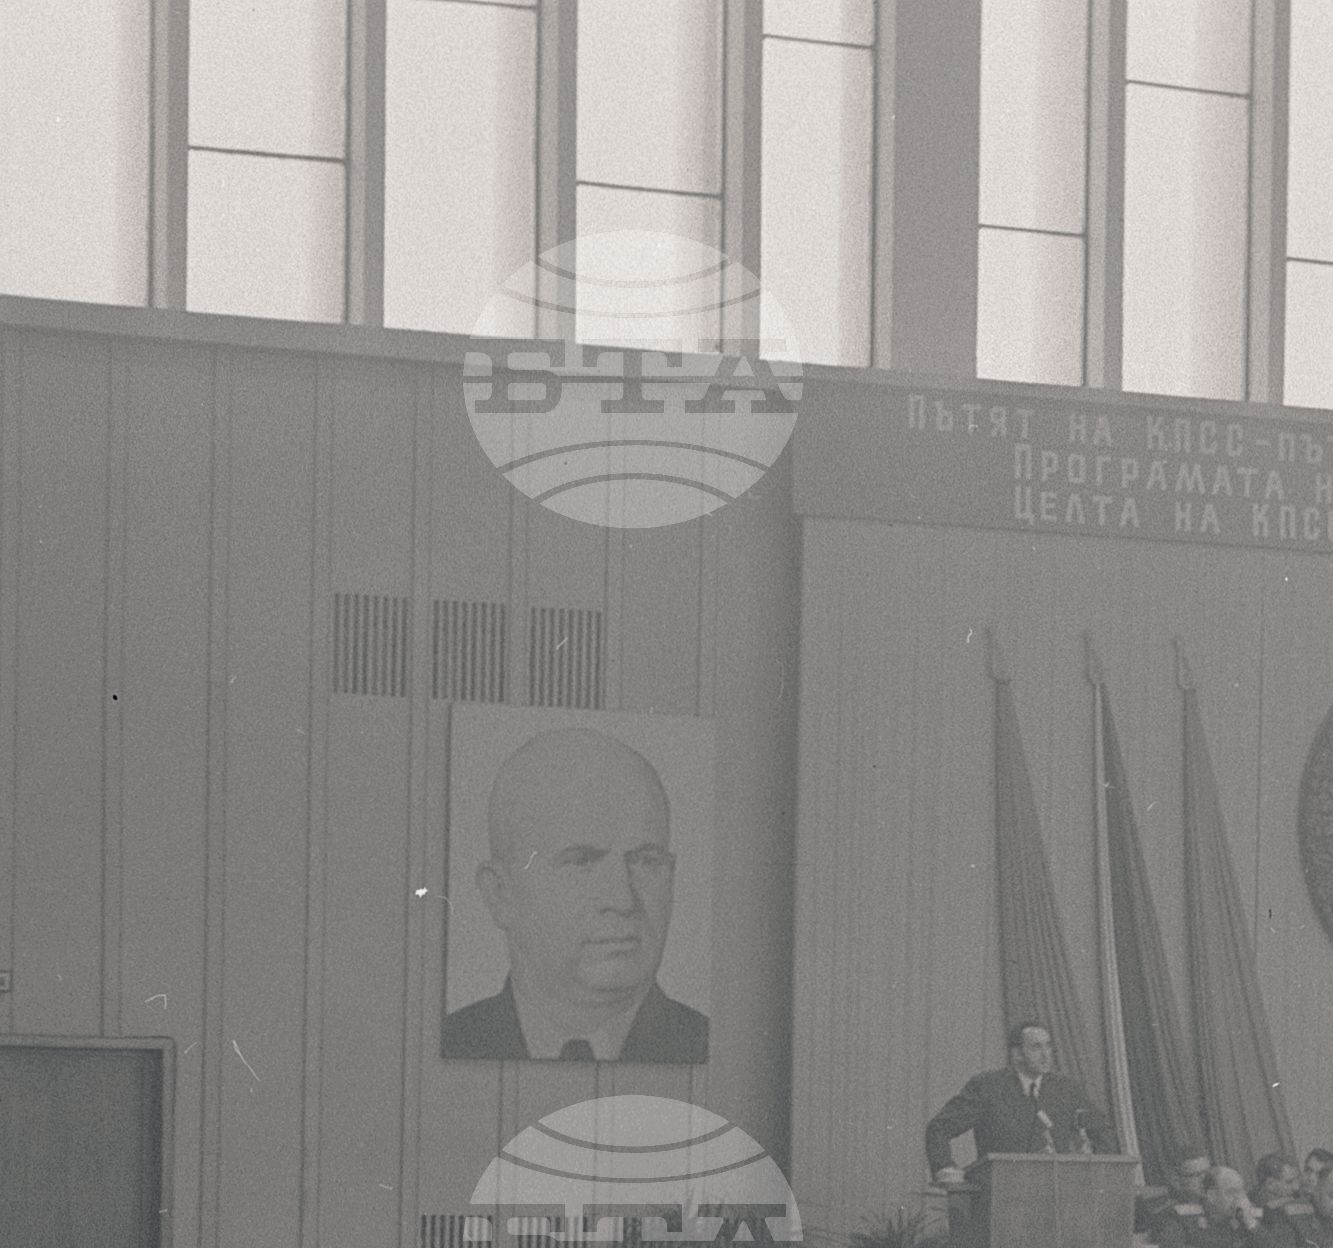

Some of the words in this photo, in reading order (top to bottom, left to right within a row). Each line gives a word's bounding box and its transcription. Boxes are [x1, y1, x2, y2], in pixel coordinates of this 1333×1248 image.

[1069, 412, 1113, 446] НА
[1013, 443, 1284, 500] ПРОГРАМАТА
[1013, 486, 1141, 528] ЦЕЛТА
[1174, 501, 1221, 535] НА
